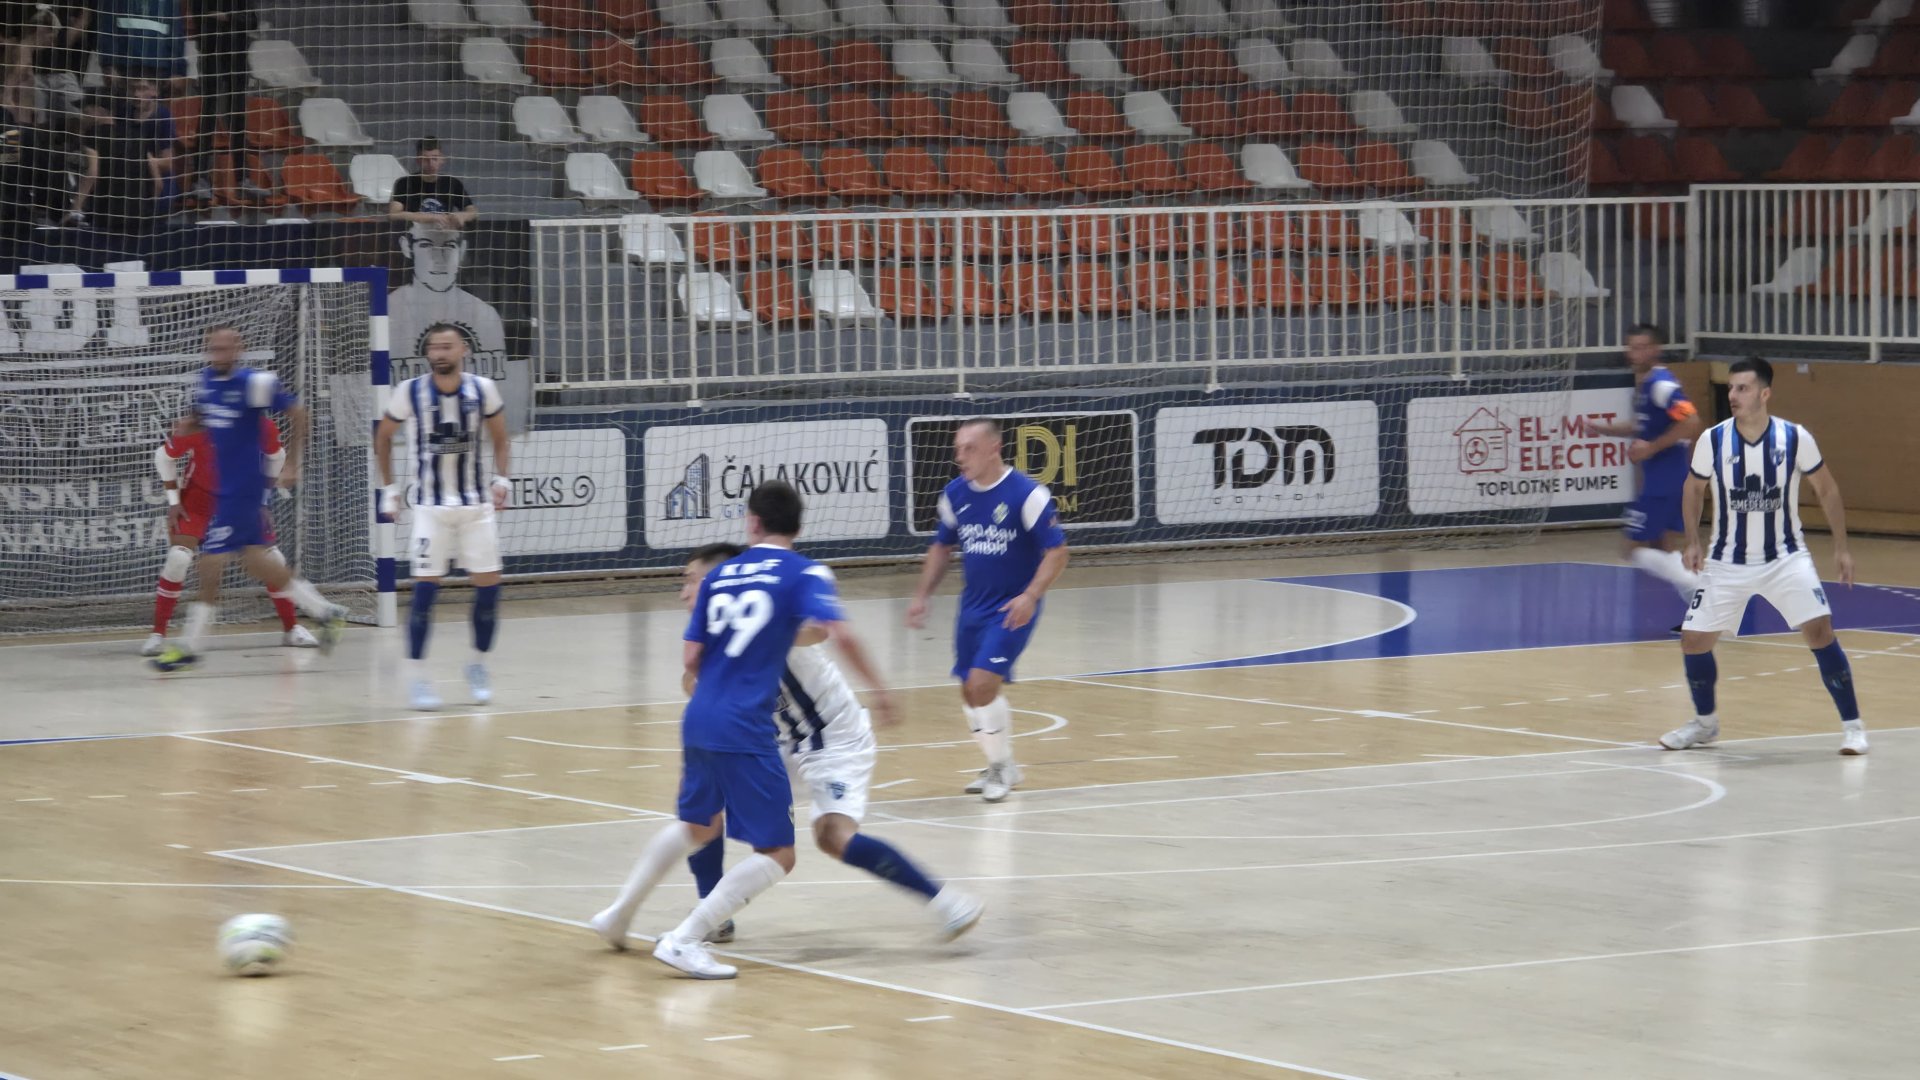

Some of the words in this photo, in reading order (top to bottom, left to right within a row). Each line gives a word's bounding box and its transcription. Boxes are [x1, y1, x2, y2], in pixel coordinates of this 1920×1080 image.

[1478, 477, 1560, 497] TOPLOTNE
[1566, 475, 1618, 493] PUMPE
[707, 590, 774, 658] 99
